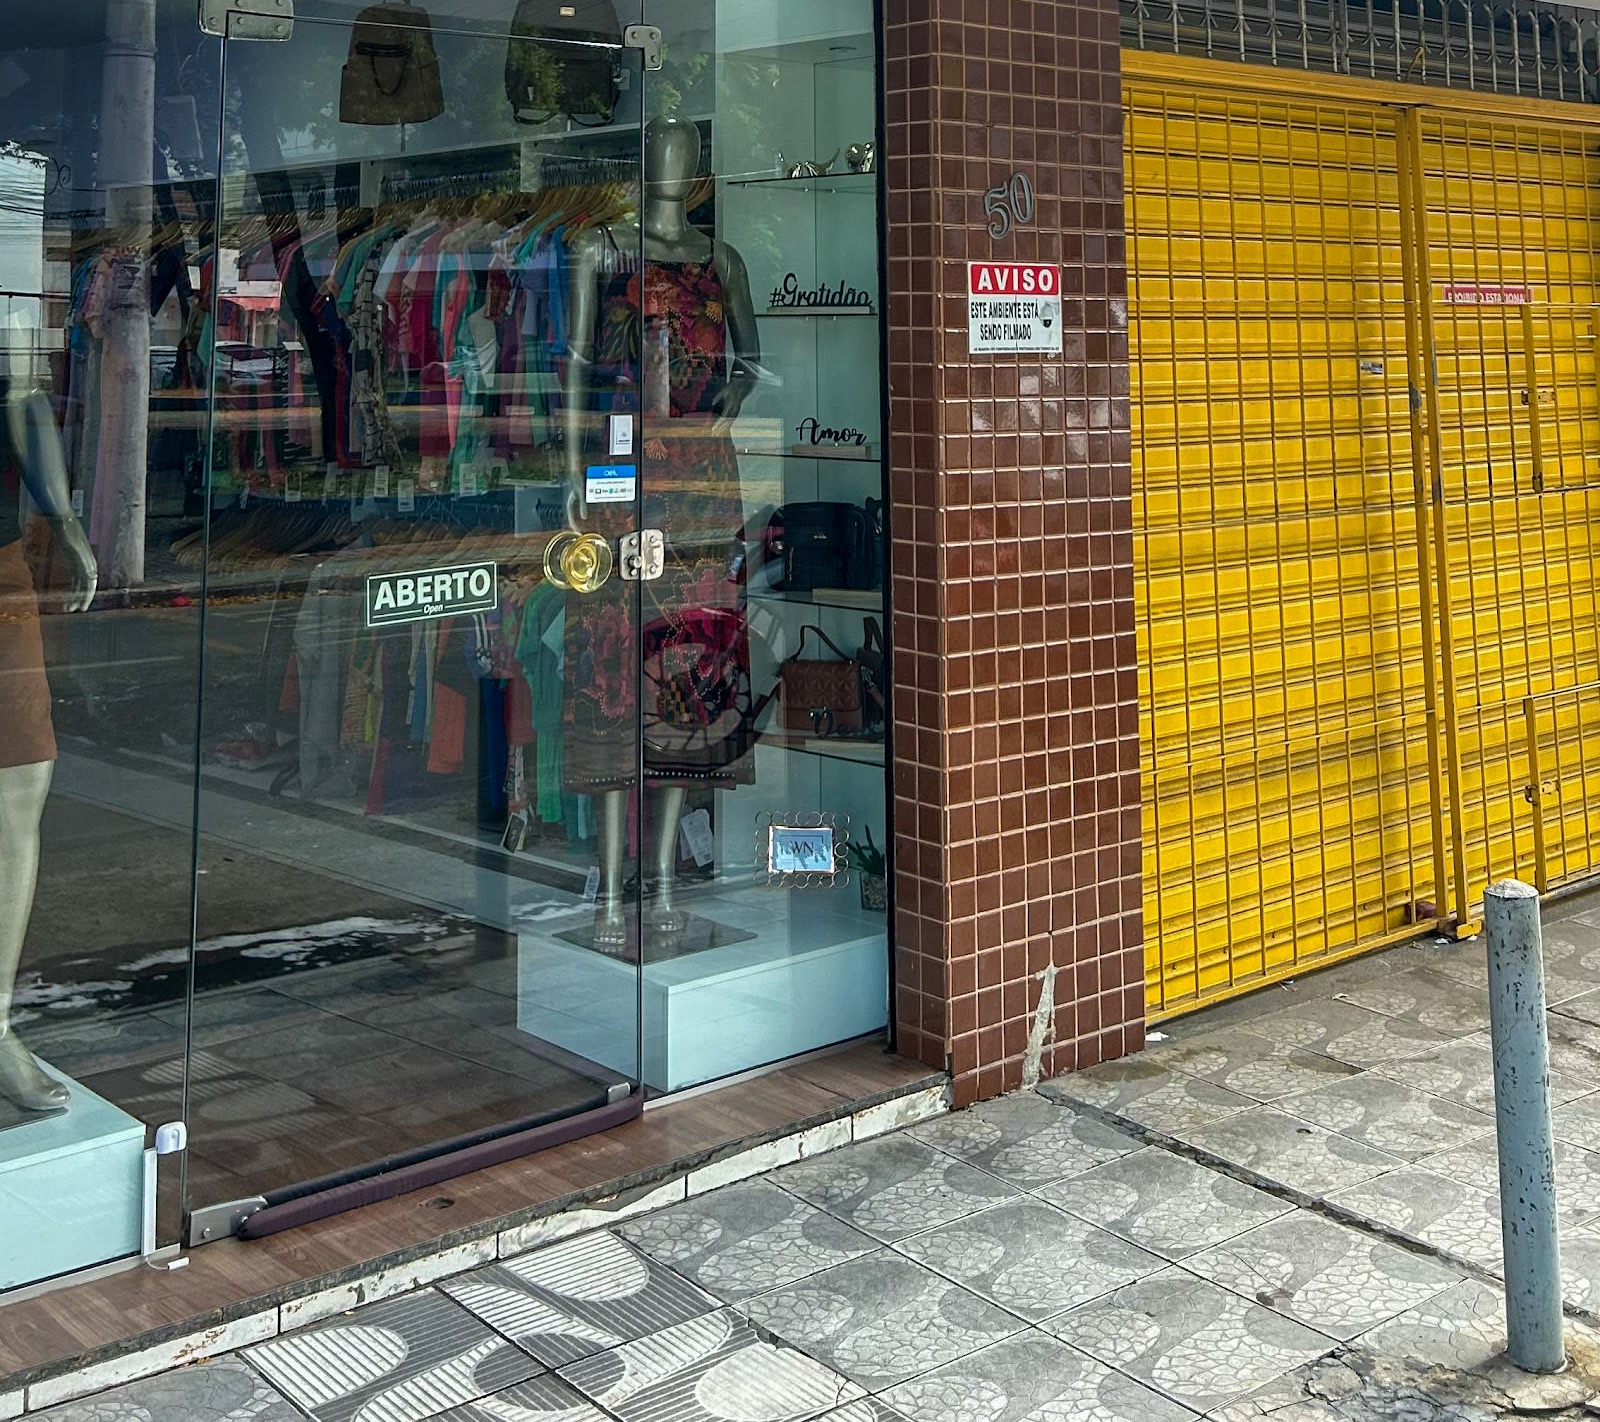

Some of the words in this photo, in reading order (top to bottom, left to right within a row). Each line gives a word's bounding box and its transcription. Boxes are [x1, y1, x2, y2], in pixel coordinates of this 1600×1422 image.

[984, 171, 1034, 239] 50
[977, 268, 1053, 292] AVISO
[971, 302, 987, 318] ESTE
[989, 302, 1021, 318] AMBIENTE
[1023, 298, 1039, 318] ESTÁ
[980, 323, 1001, 340] SENDO
[1003, 323, 1032, 340] FILMADO
[796, 417, 867, 446] Amor
[374, 568, 491, 610] ABERTO
[423, 604, 444, 615] Open
